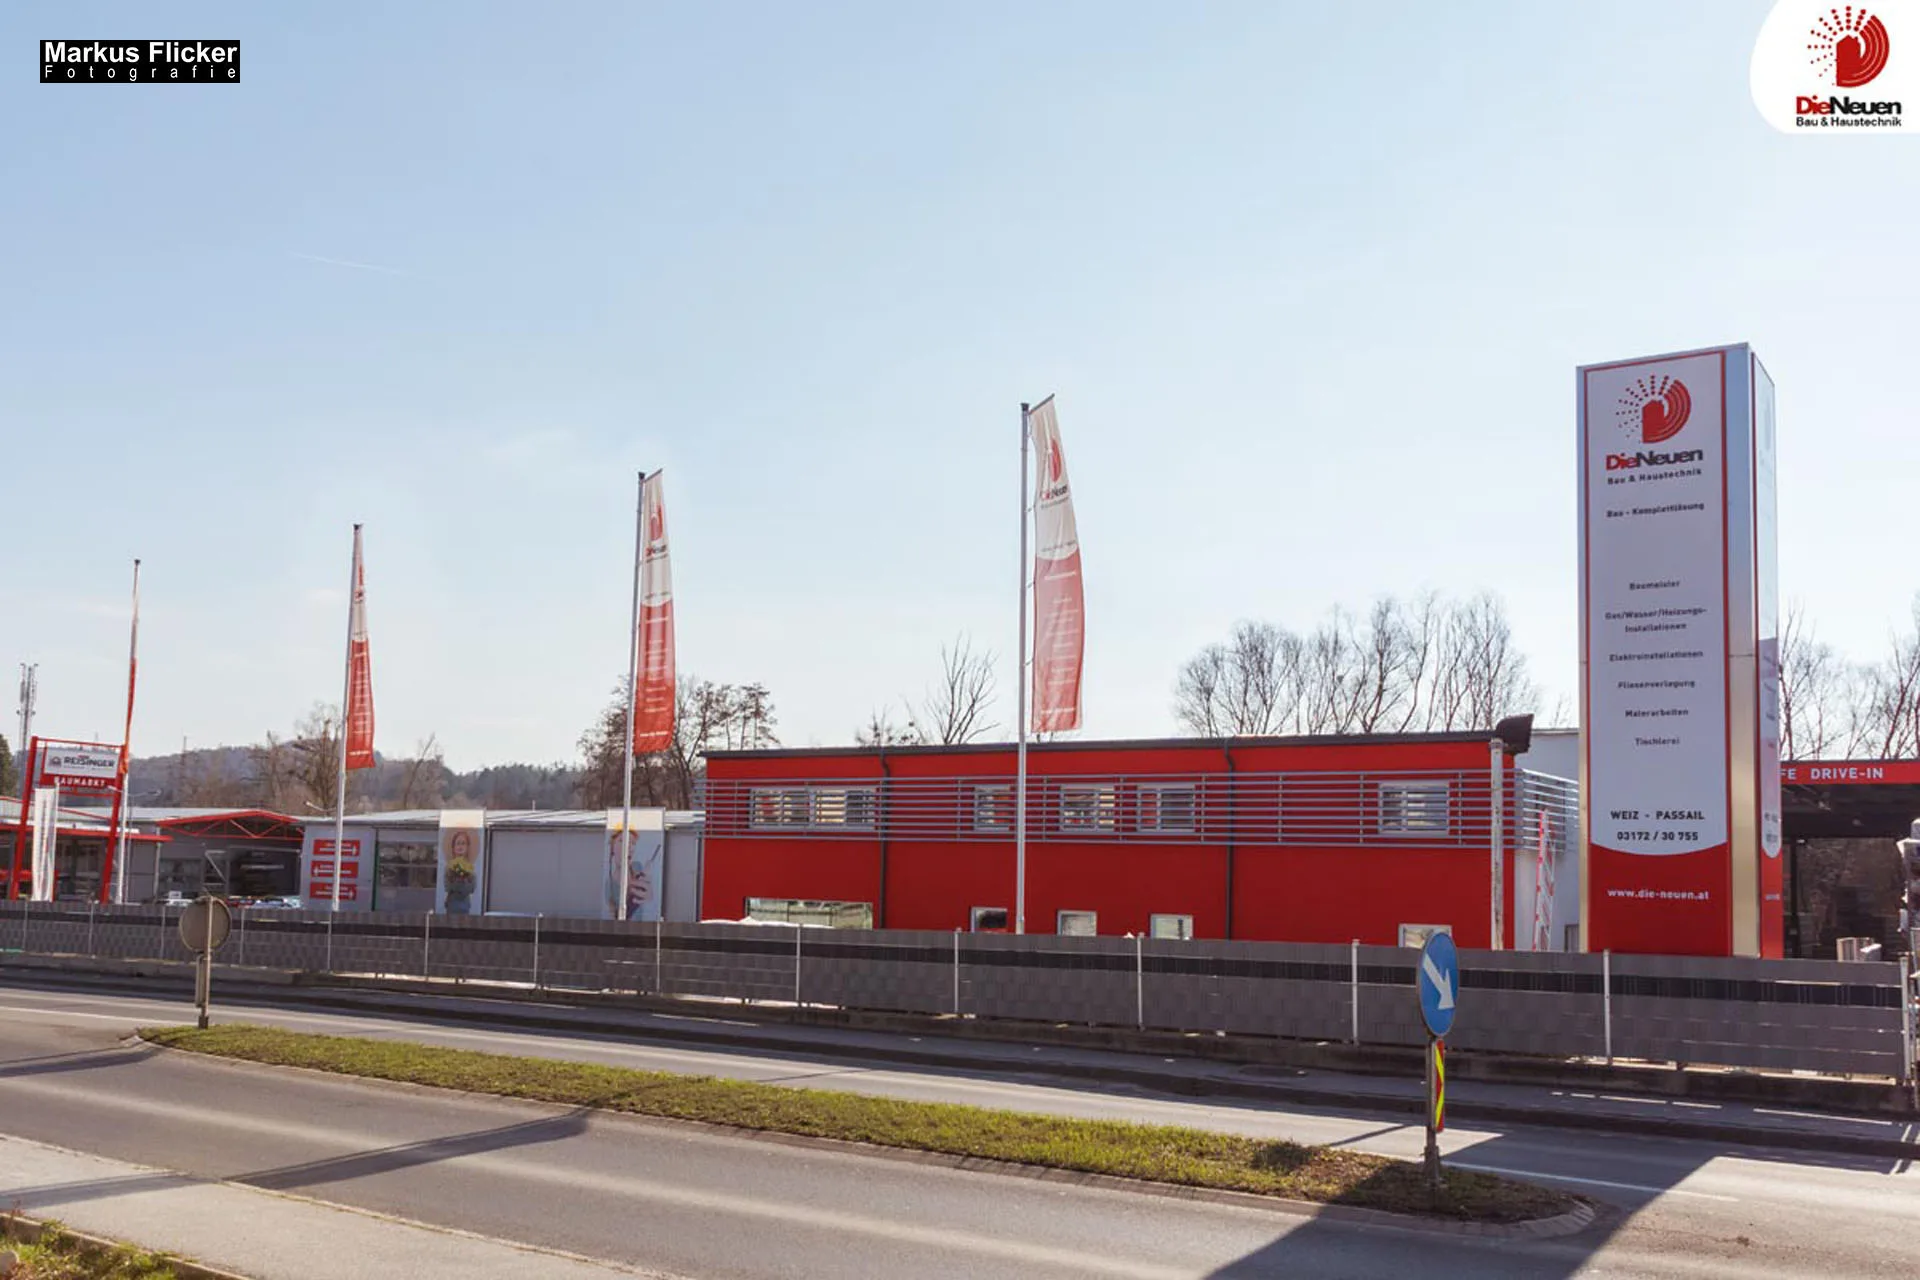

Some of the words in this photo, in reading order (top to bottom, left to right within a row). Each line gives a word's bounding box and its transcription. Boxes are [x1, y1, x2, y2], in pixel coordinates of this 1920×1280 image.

[1606, 449, 1704, 471] DieNeuen
[1607, 476, 1626, 486] Bau
[1629, 474, 1636, 483] &
[1639, 467, 1702, 482] Haustechnik
[1606, 509, 1624, 518] Bau
[1632, 502, 1705, 516] Komplettlösung
[1629, 580, 1681, 590] Baumeister
[1625, 622, 1687, 633] Installationen
[1609, 650, 1703, 662] Elektroinstallationen
[1617, 679, 1695, 690] Fliesenverlegung
[1625, 708, 1689, 718] Malerarbeiten
[1635, 737, 1680, 746] Tischlerei
[1810, 767, 1883, 780] DRIVE-IN
[1610, 810, 1639, 820] WEIZ
[1656, 810, 1705, 820] PASSAIL
[1617, 831, 1650, 841] 03172
[1661, 831, 1675, 841] 30
[1678, 831, 1699, 841] 755
[1607, 888, 1709, 900] www.die-neuen.at
